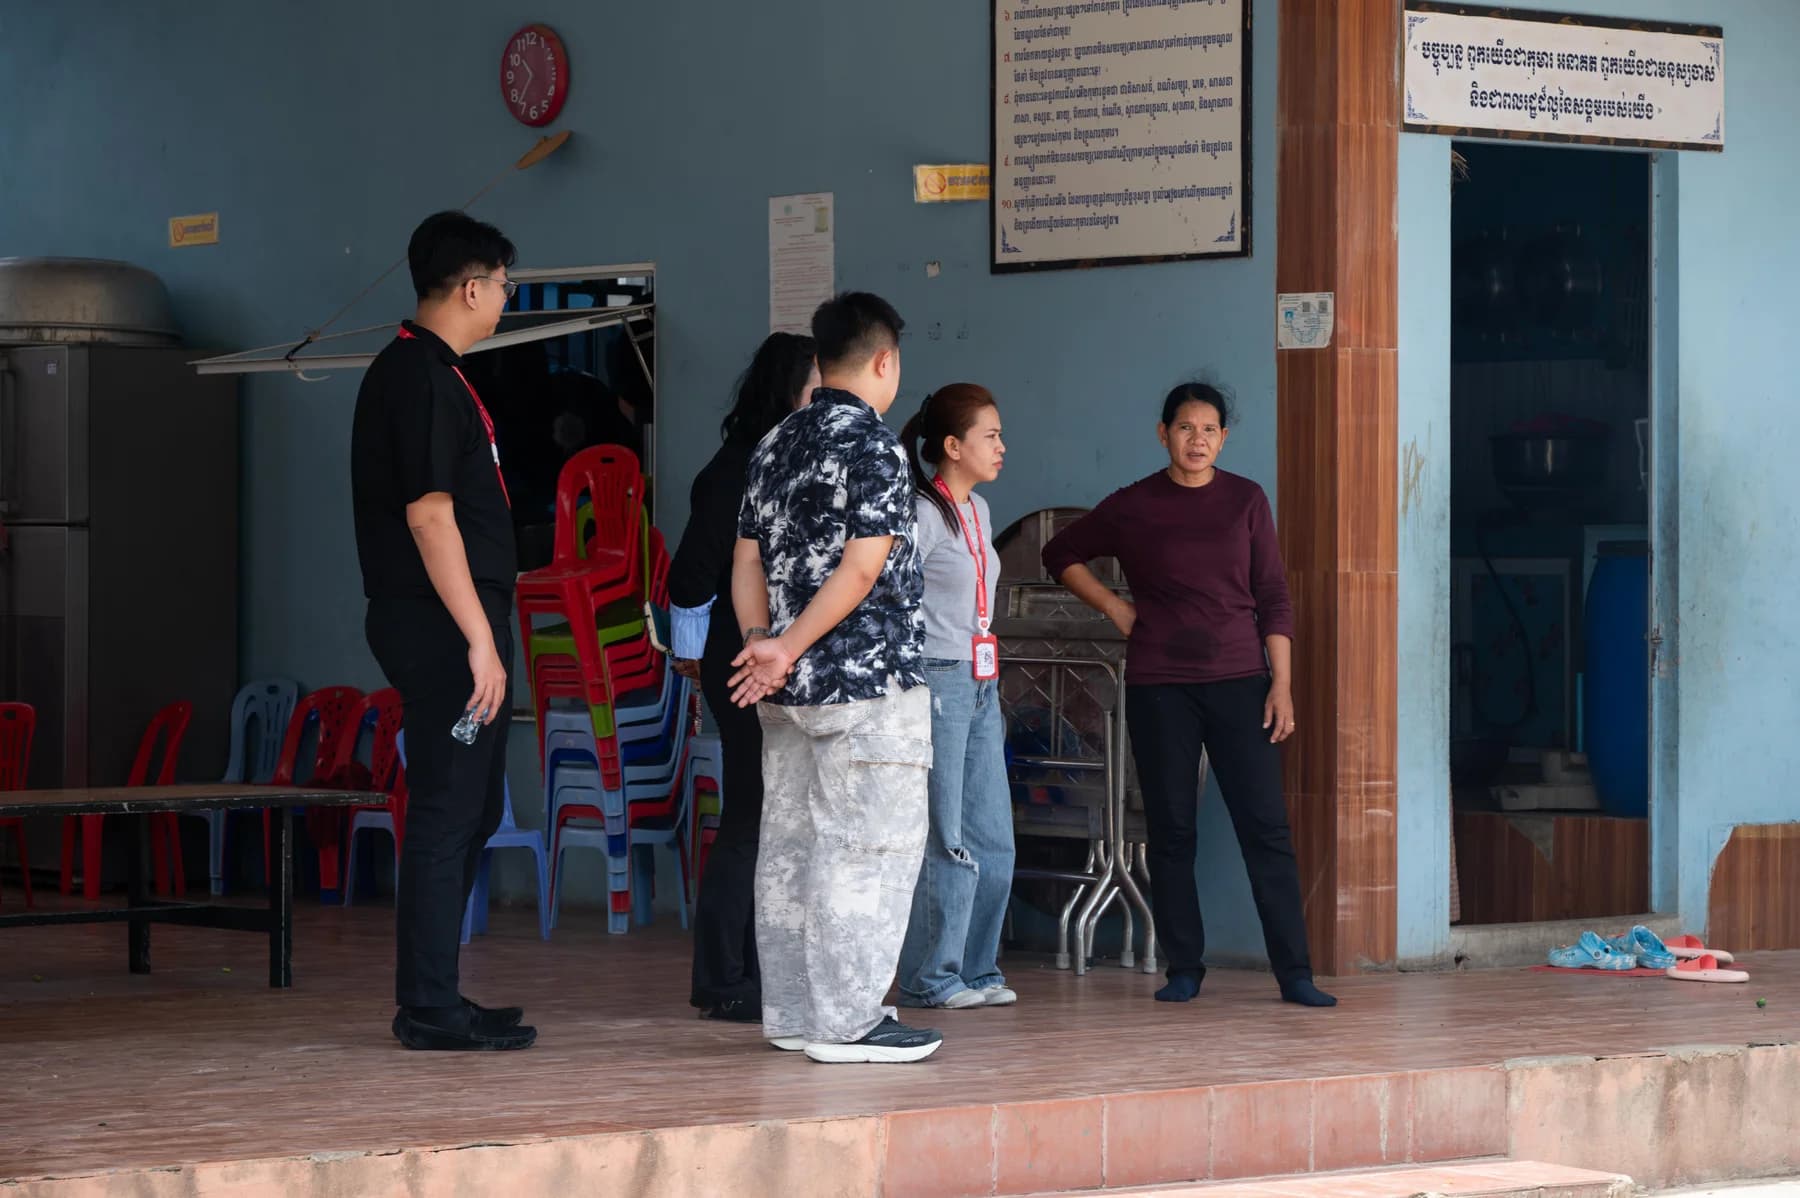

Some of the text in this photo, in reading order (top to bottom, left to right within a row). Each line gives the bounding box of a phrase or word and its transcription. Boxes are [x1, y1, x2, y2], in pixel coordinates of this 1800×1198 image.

[525, 32, 537, 44] 12
[540, 37, 545, 48] 1
[517, 39, 526, 51] 11
[510, 54, 520, 66] 10
[1422, 38, 1716, 88] បច្ចុប្បន្ន ពួកយើងជាកុមារ អនាគត ពួកយើងជាមនុស្សចាស់
[506, 71, 514, 84] 9
[511, 89, 518, 102] 8
[520, 102, 526, 115] 7
[541, 100, 549, 112] 5
[529, 106, 538, 119] 6
